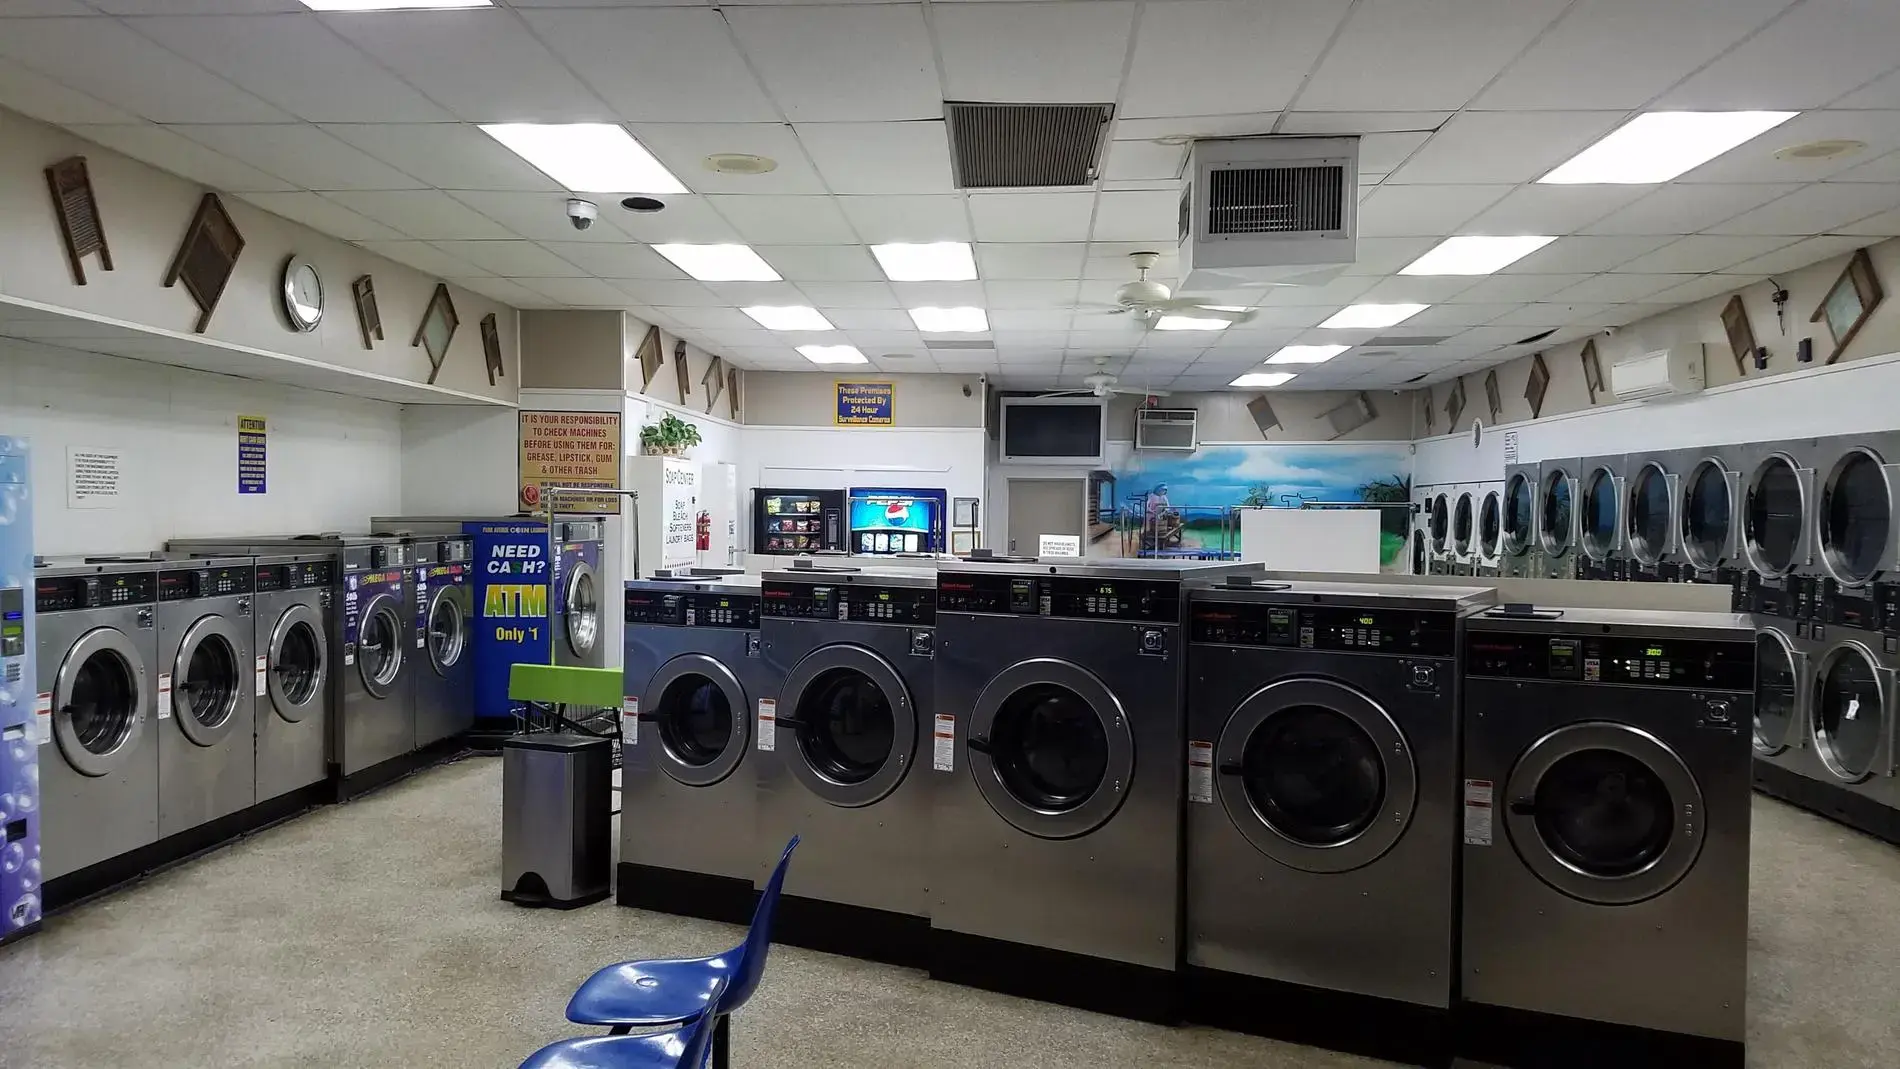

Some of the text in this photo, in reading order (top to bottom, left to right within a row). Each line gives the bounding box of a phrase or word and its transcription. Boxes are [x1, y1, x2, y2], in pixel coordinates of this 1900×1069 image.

[843, 396, 887, 406] Protected By
[522, 414, 618, 425] IT IS YOUR RESPONSIBILITY
[533, 428, 607, 438] TO CHECK MACHINES
[524, 440, 616, 450] BEFORE USING THEM FOR:
[527, 452, 612, 463] GREASE, LIPSTICK, GUM
[541, 465, 598, 475] & OTHER TRASH
[492, 545, 541, 558] NEED
[483, 584, 547, 617] ATM
[496, 627, 525, 643] Only
[1646, 648, 1662, 656] 300
